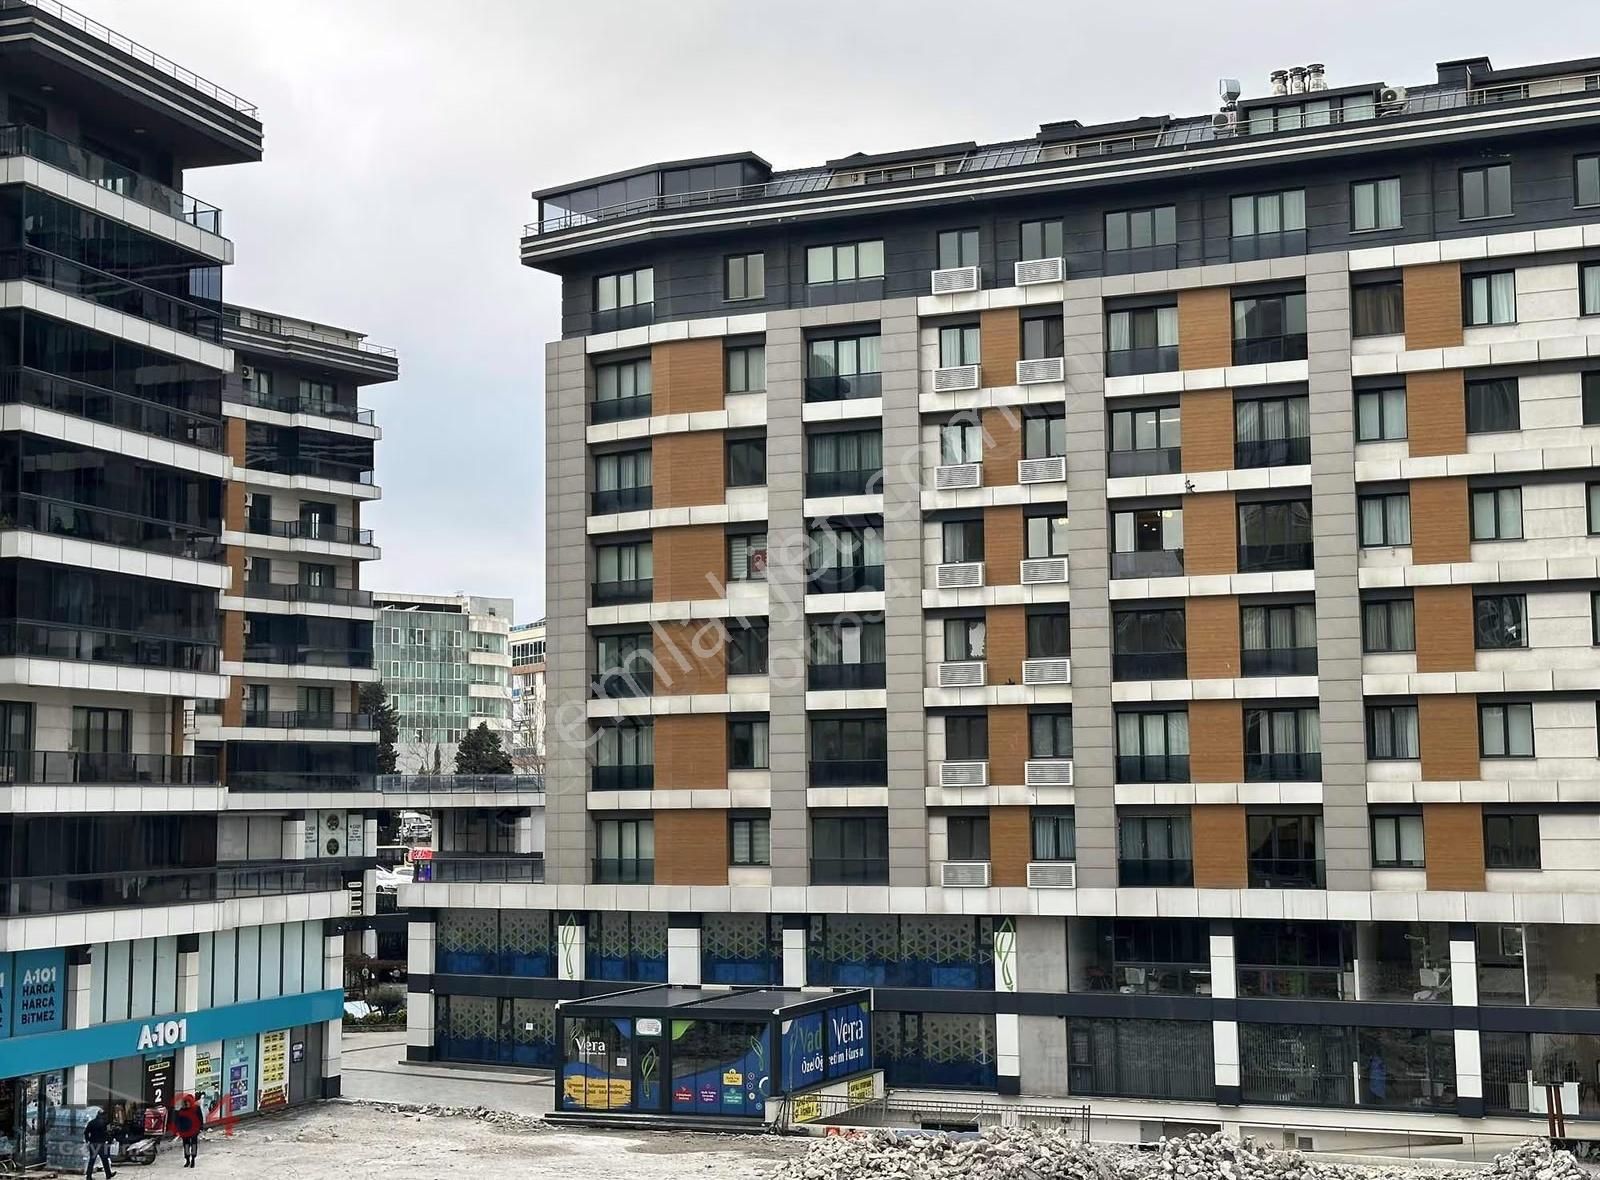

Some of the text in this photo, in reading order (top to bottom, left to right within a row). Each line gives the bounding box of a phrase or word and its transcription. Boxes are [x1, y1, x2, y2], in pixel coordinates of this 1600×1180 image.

[22, 984, 55, 997] HARCA
[22, 998, 55, 1011] HARCA
[832, 1016, 864, 1046] Vera
[575, 1037, 606, 1052] Vera
[815, 1051, 845, 1072] Öğetim
[155, 1088, 162, 1103] 2
